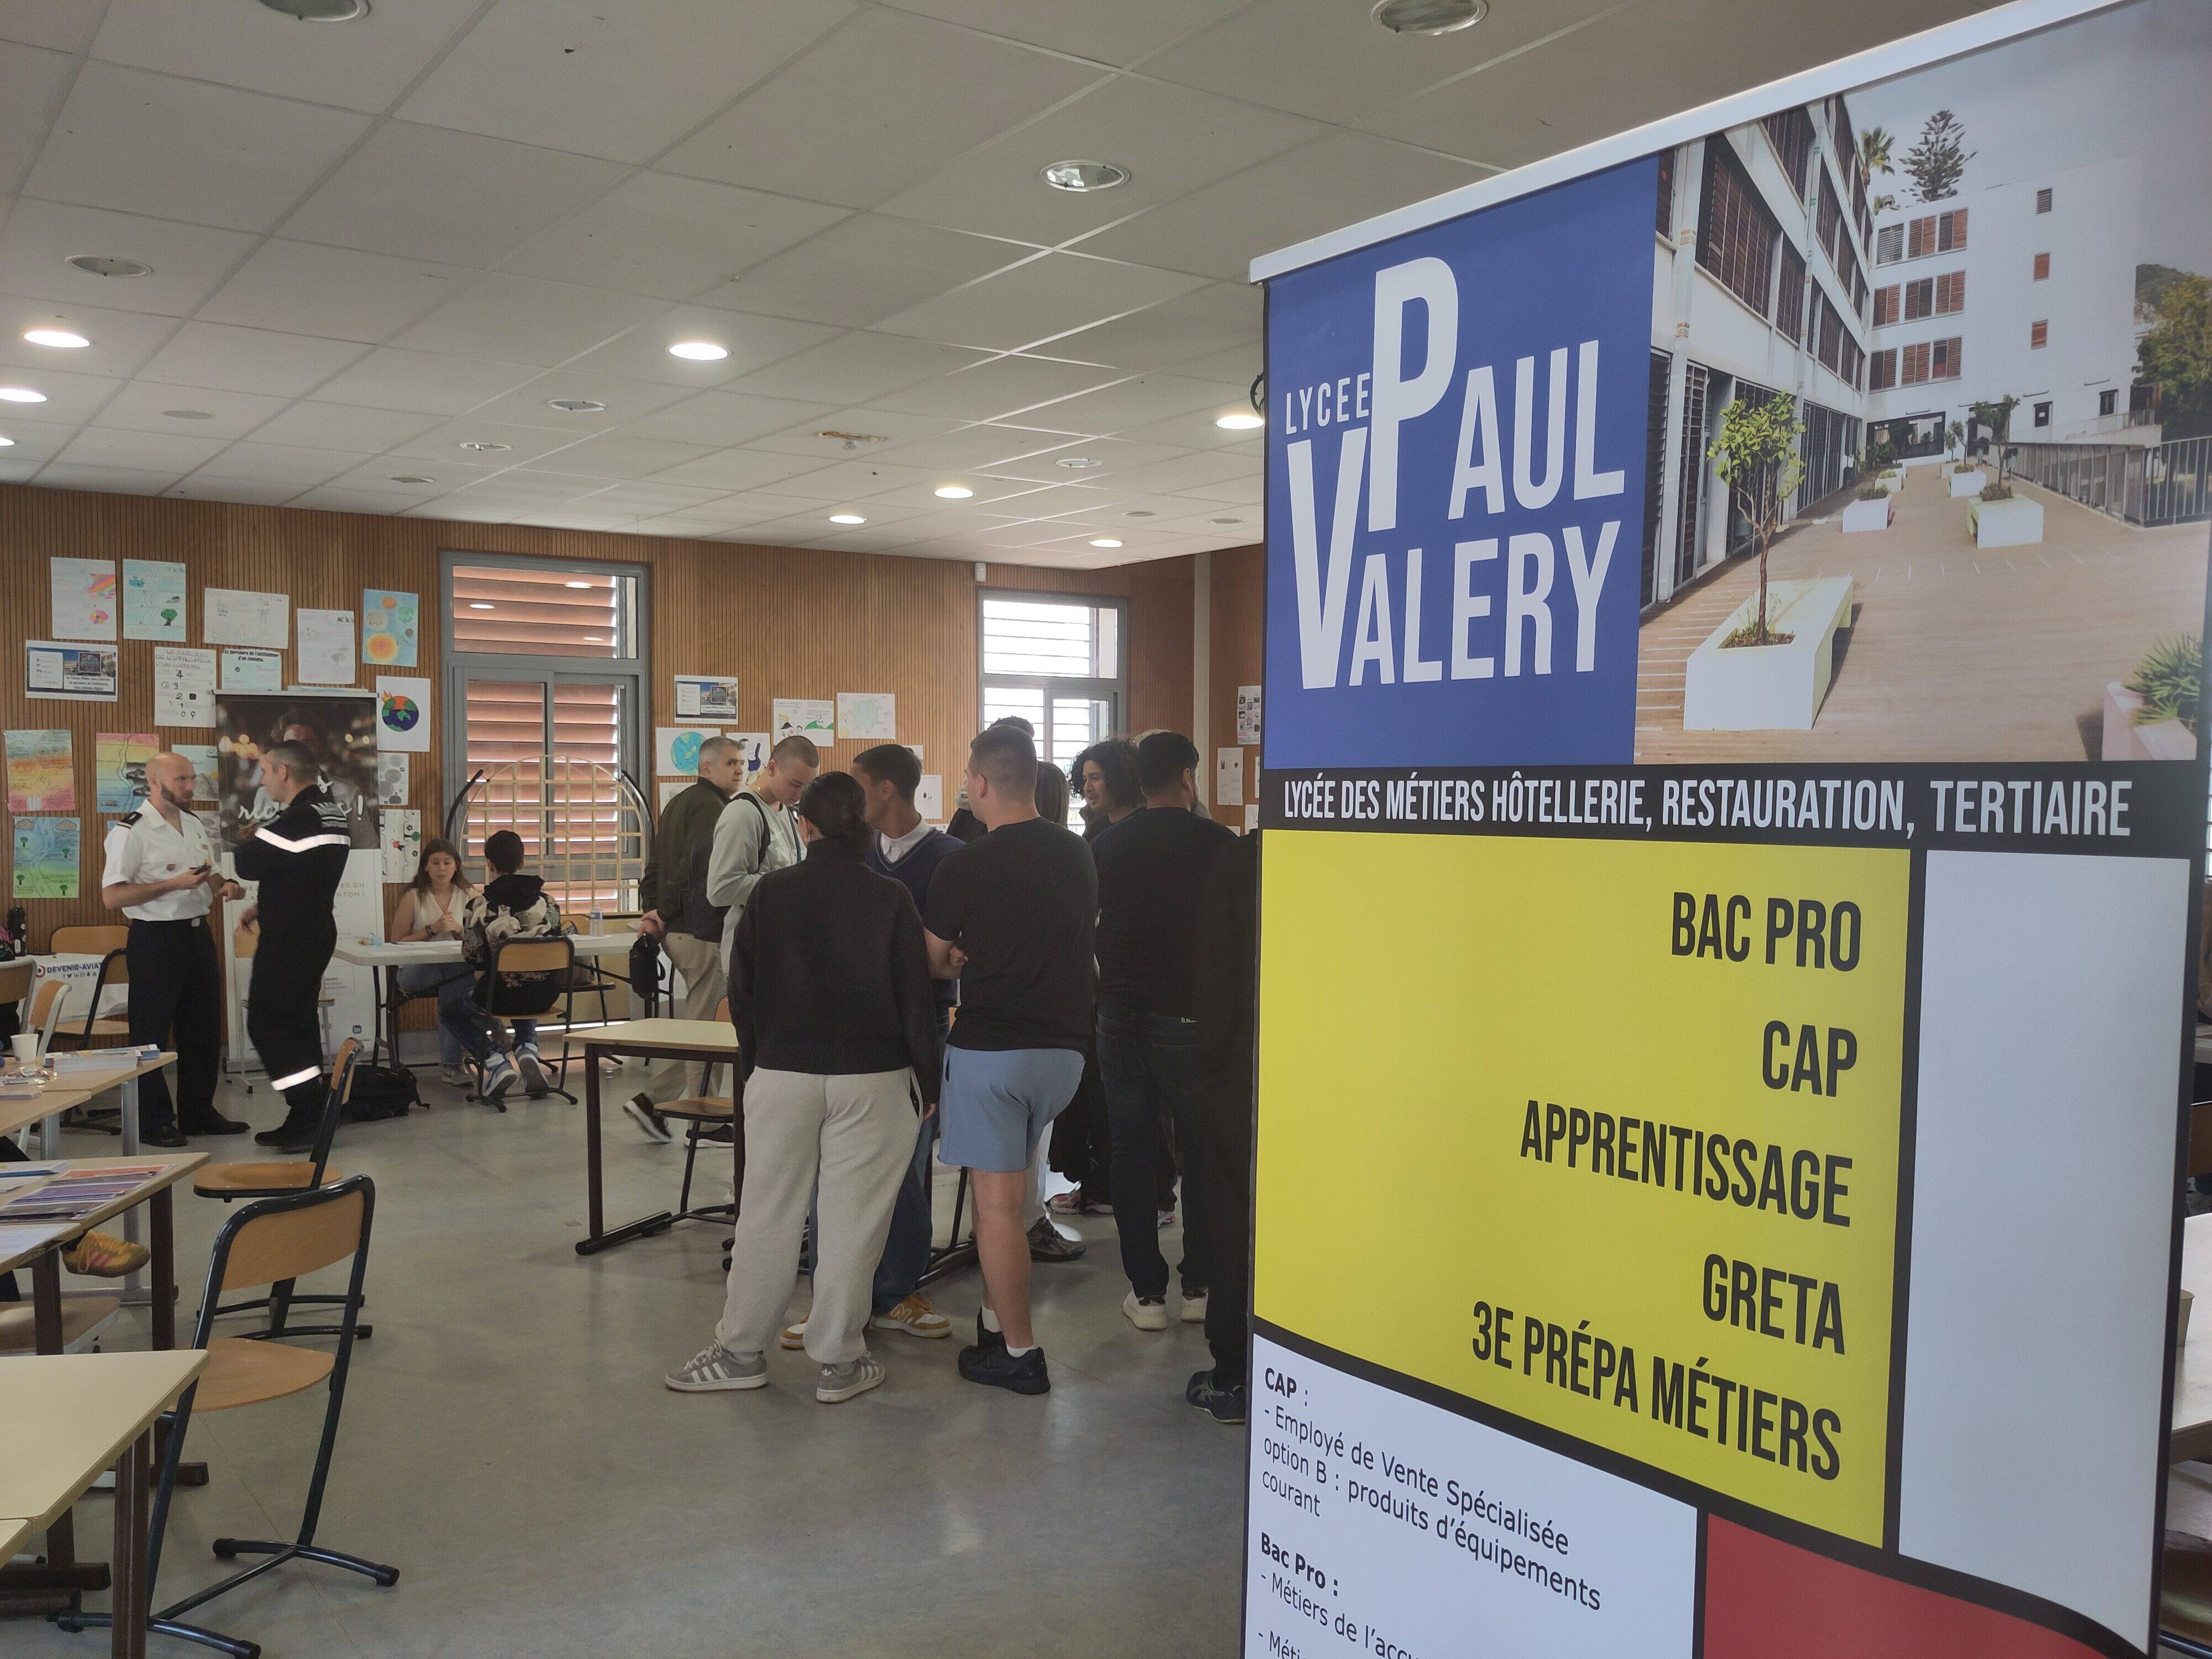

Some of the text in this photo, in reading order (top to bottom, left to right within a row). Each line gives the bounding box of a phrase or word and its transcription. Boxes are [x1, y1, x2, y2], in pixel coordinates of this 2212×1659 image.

[1286, 372, 1370, 435] LYCEE
[1368, 257, 1625, 532] PAUL
[1287, 426, 1621, 690] VALERY
[1285, 771, 2133, 840] LYCÉE DES MÉTIERS HÔTELLERIE, RESTAURATION, TERTIAIRE
[47, 963, 102, 973] DEVENIR-AVIA
[1671, 891, 1861, 972] BAC PRO
[1762, 1020, 1858, 1098] CAP
[1520, 1099, 1853, 1228] APPRENTISSAGE
[1703, 1254, 1845, 1355] GRETA
[1265, 1367, 1297, 1399] CAP
[1472, 1301, 1841, 1481] 3E PRÉPA MÉTIERS
[1262, 1471, 1321, 1517] courant
[1275, 1405, 1344, 1457] Employé
[1351, 1442, 1374, 1470] de
[1381, 1452, 1438, 1498] Vente
[1446, 1480, 1569, 1556] Spécialisée
[1261, 1532, 1290, 1569] Bac
[1295, 1553, 1326, 1589] Pro
[1264, 1438, 1309, 1476] option
[1316, 1459, 1327, 1484] B
[1348, 1480, 1429, 1530] produits
[1436, 1515, 1600, 1611] d'équipements
[1272, 1572, 1328, 1626] Métiers
[1334, 1613, 1357, 1642] de
